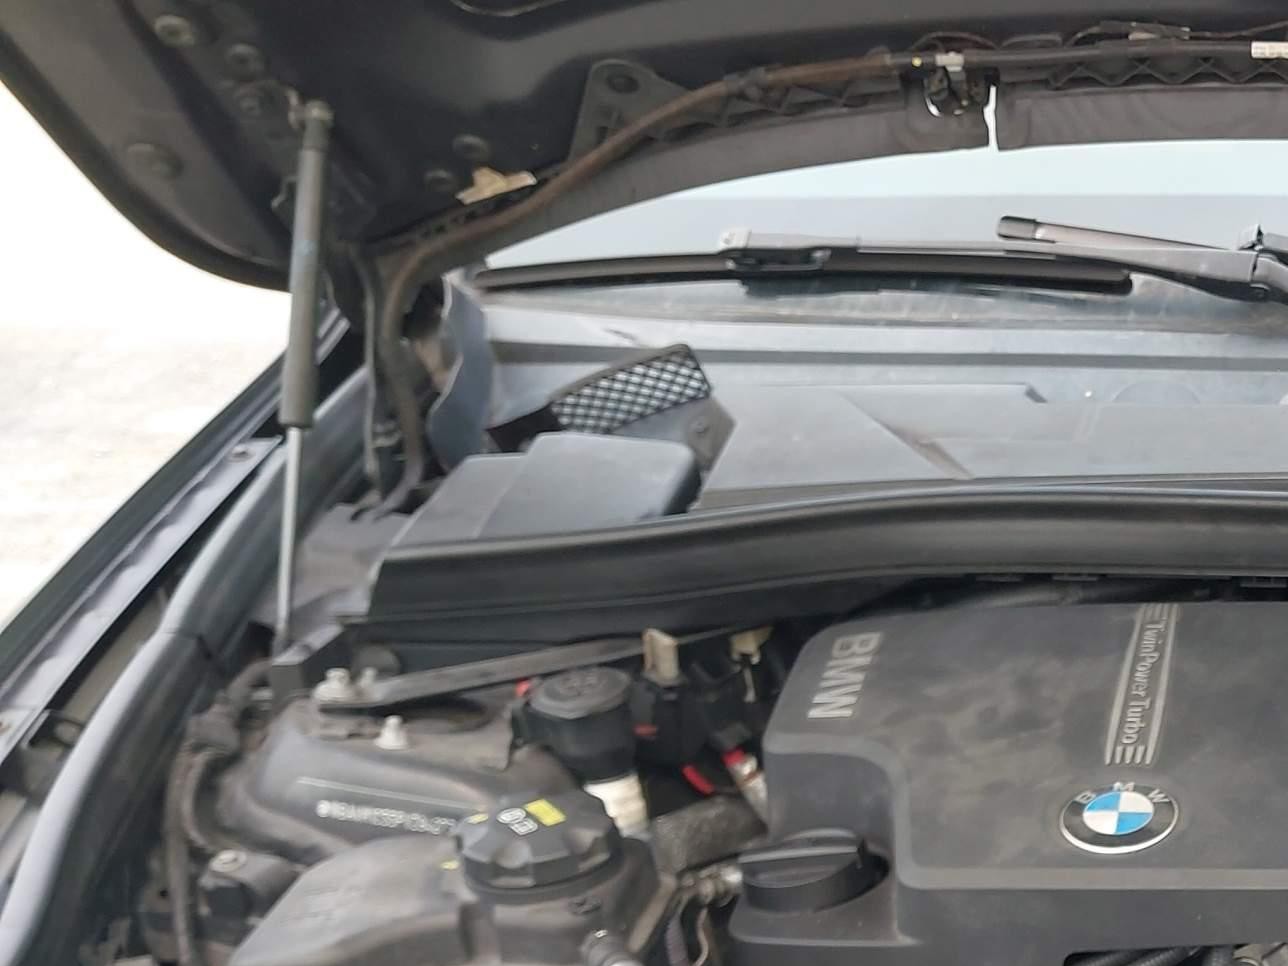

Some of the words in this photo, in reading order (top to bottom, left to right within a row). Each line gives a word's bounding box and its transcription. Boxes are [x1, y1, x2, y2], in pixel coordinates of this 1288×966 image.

[807, 631, 882, 718] BMW
[1131, 616, 1166, 697] TwinPower
[1122, 697, 1151, 744] Turbo
